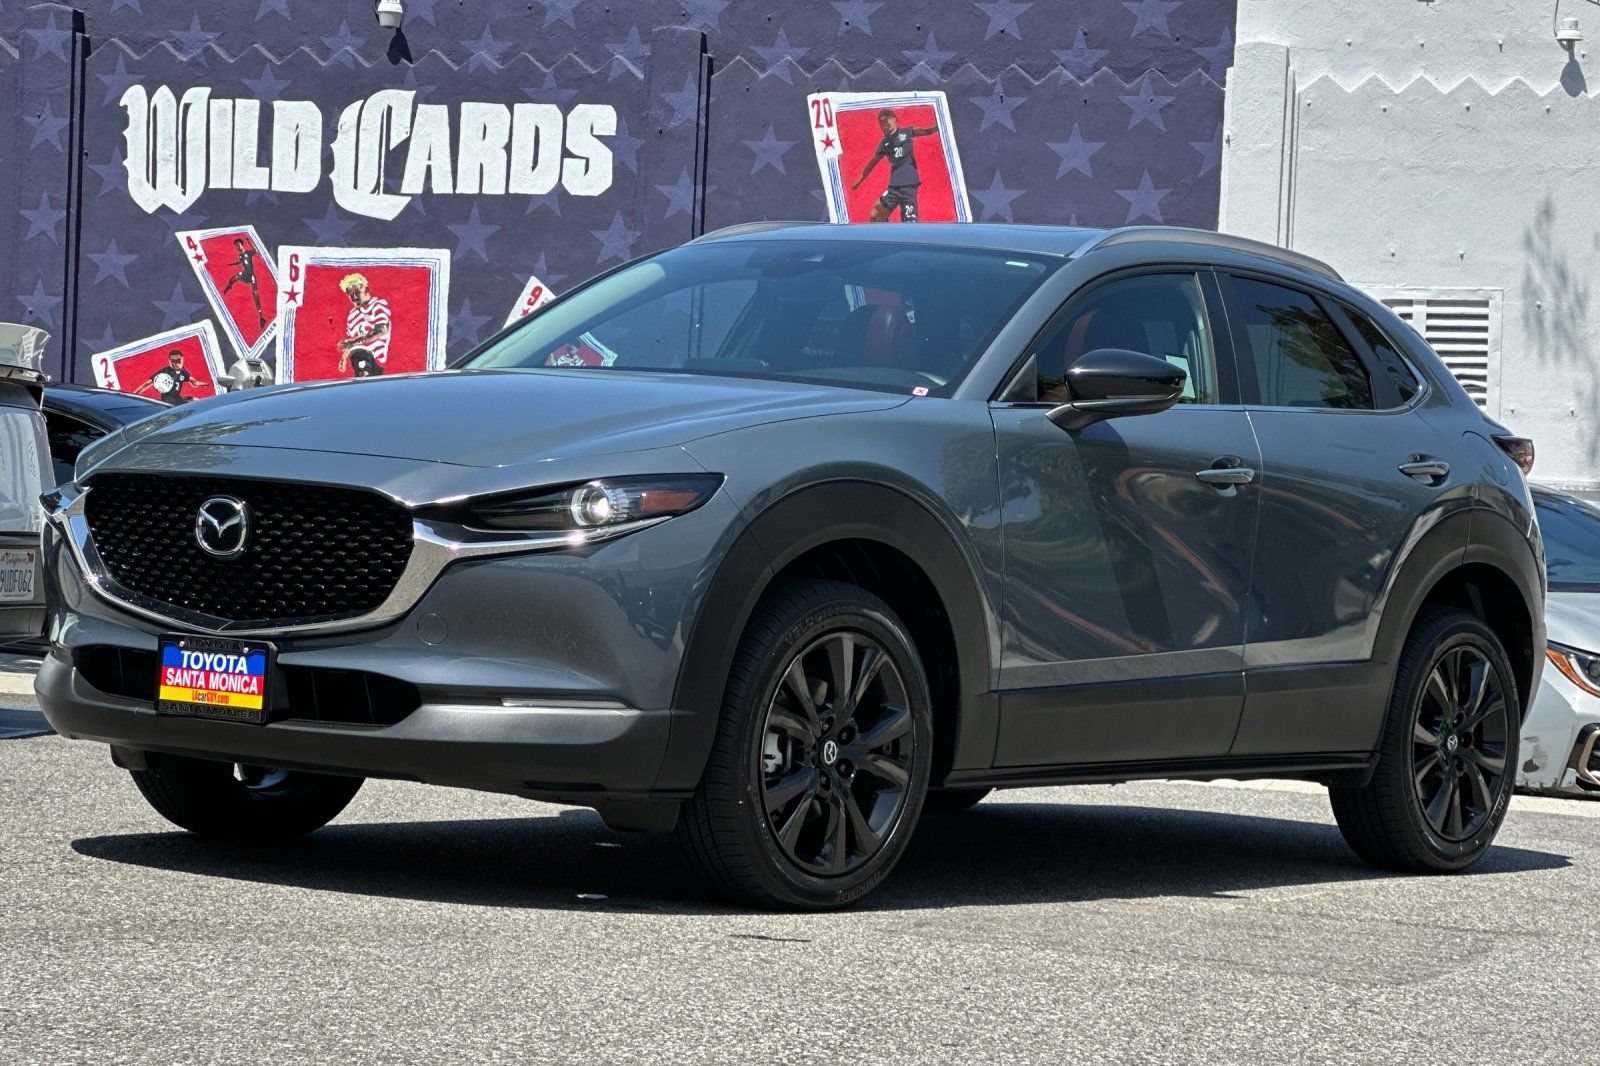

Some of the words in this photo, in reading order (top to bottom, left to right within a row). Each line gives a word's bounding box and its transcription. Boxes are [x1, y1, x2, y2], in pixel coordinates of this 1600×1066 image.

[811, 98, 833, 129] 20
[120, 85, 322, 214] WILD
[330, 89, 617, 220] CARDS
[894, 146, 903, 158] 20
[186, 235, 198, 250] 4
[289, 253, 299, 282] 6
[527, 285, 543, 306] 9
[99, 357, 111, 379] 2
[180, 650, 248, 674] TOYOTA
[166, 668, 206, 689] SANTA
[209, 673, 258, 694] MONICA
